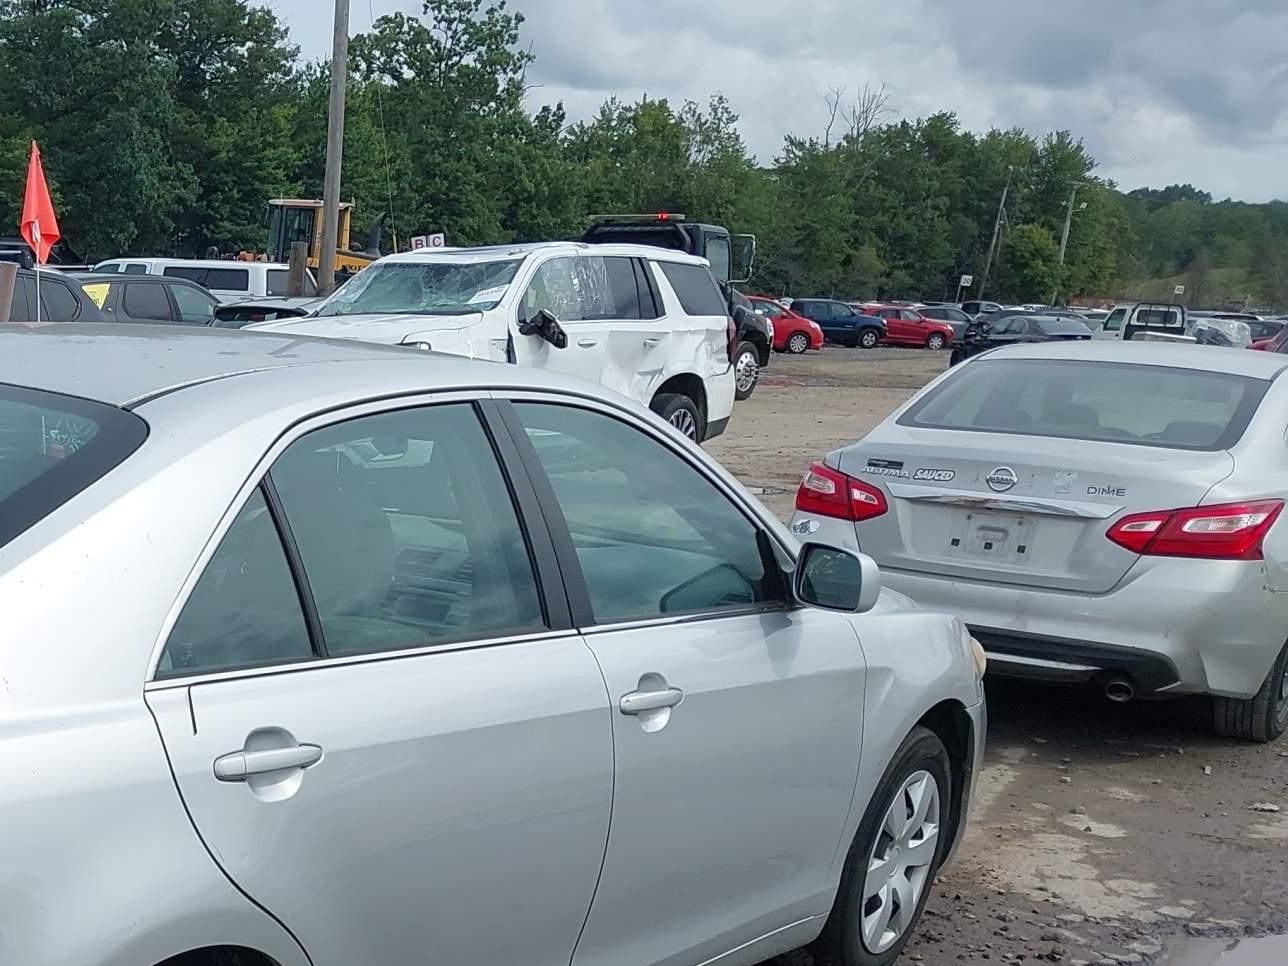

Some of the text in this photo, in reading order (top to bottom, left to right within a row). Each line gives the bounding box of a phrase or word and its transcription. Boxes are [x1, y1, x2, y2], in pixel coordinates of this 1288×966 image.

[414, 239, 424, 249] B
[433, 236, 442, 247] C
[862, 466, 910, 479] ALTIMA
[914, 469, 954, 480] SAUCED
[988, 475, 1015, 483] NISSAN
